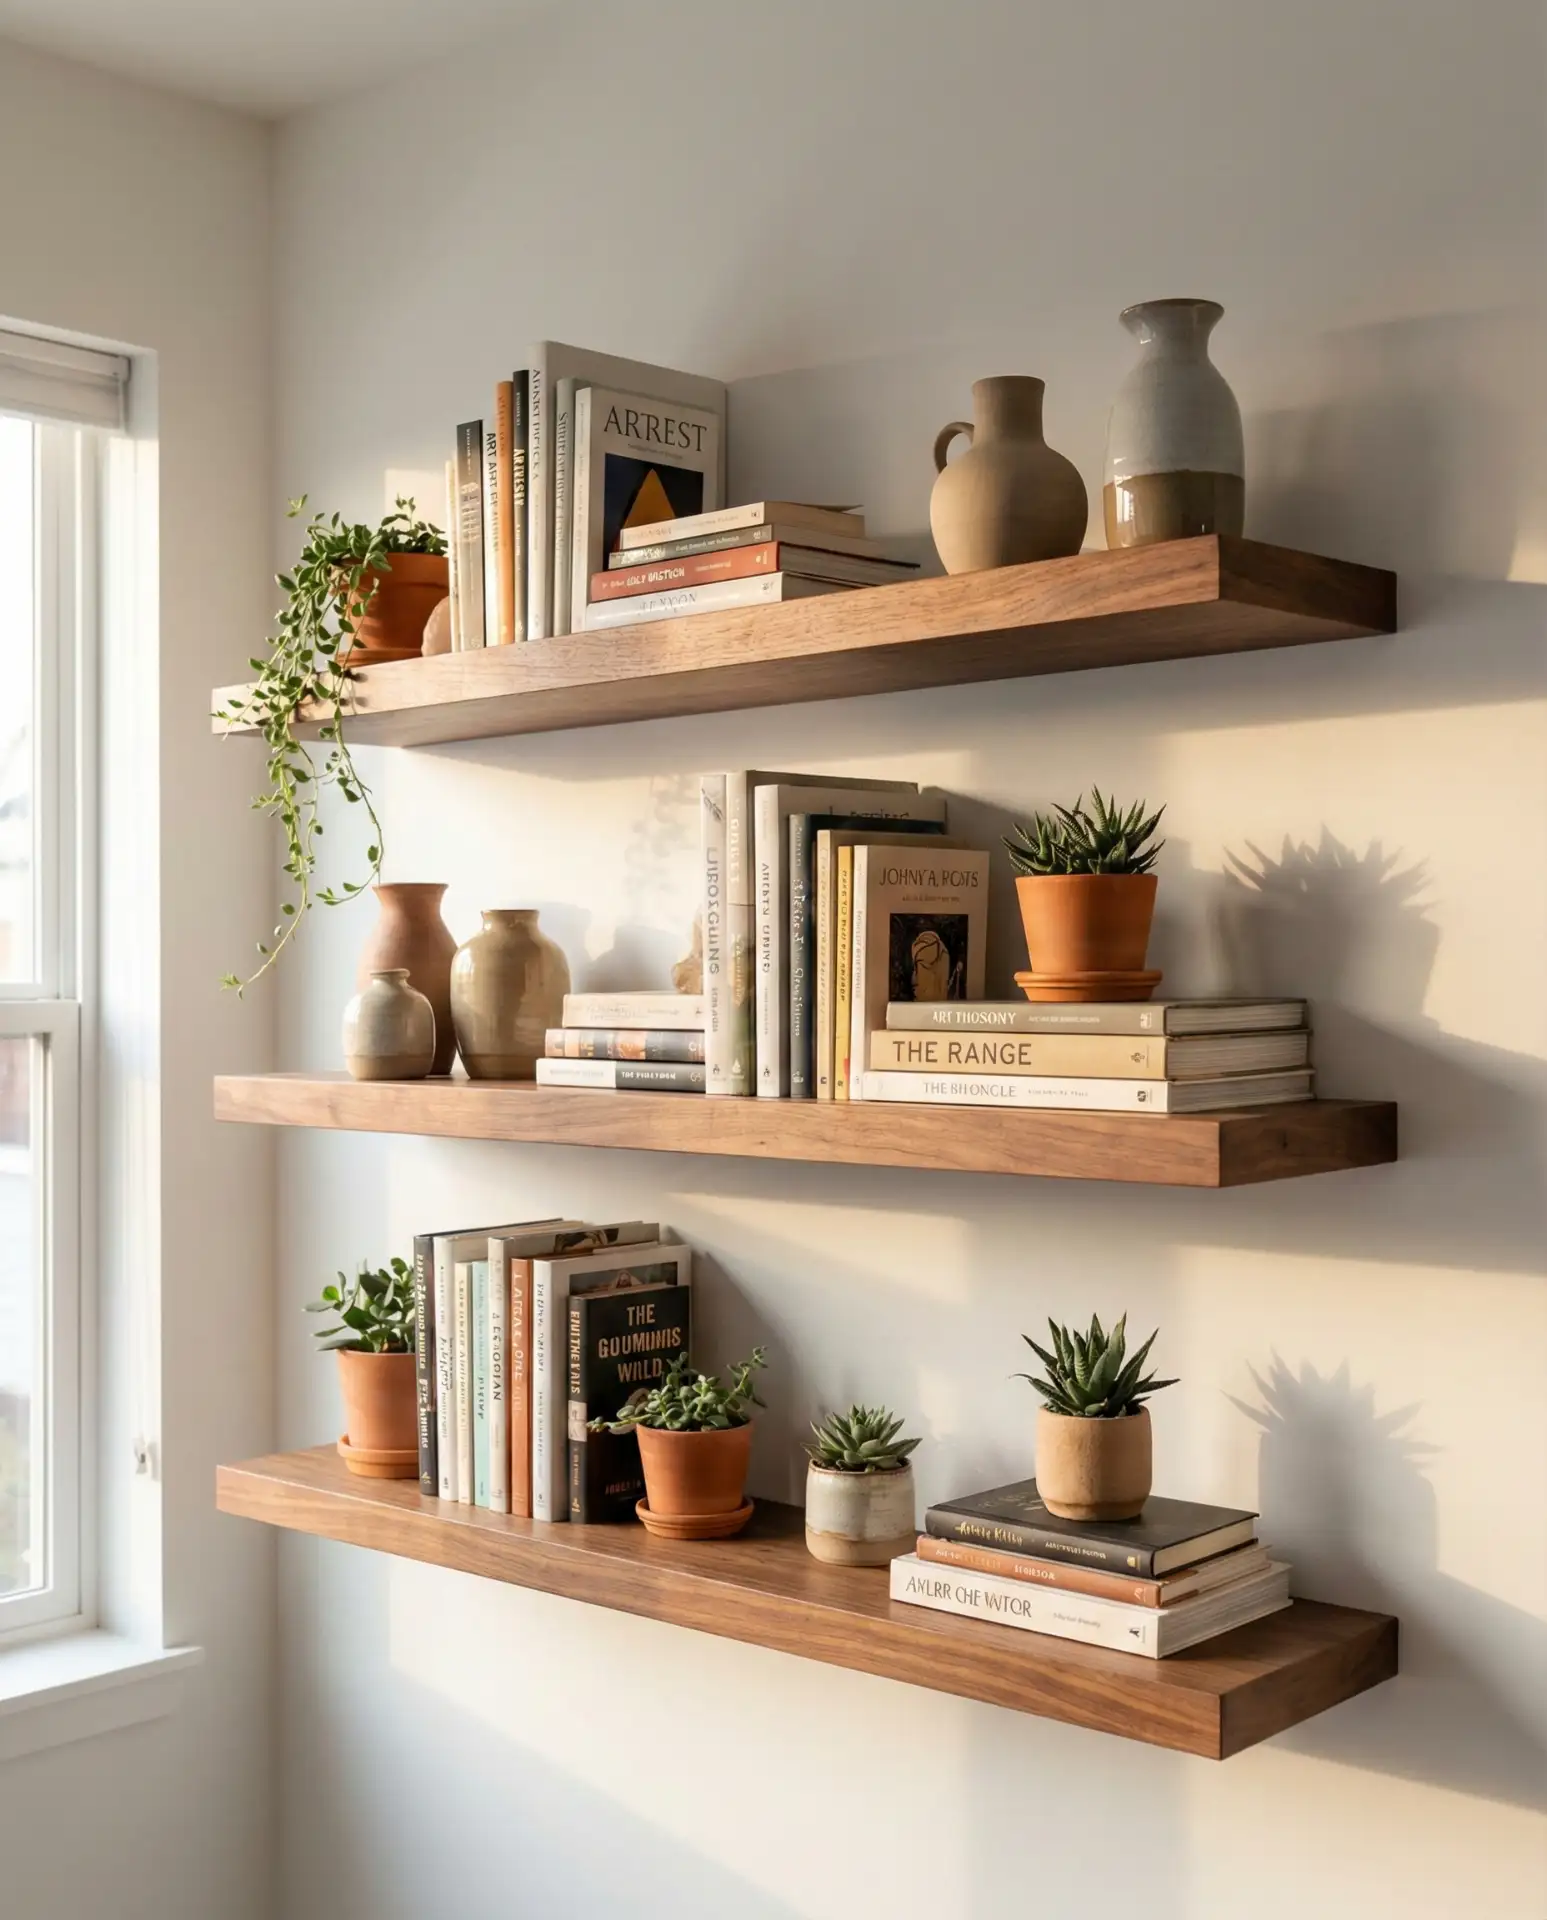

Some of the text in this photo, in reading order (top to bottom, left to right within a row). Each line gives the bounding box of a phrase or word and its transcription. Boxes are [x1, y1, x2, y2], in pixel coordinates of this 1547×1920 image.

[603, 405, 708, 452] ARREST
[486, 432, 497, 457] ART
[893, 1041, 1032, 1066] THE RANGE
[923, 1082, 947, 1095] THE
[626, 1304, 656, 1327] THE
